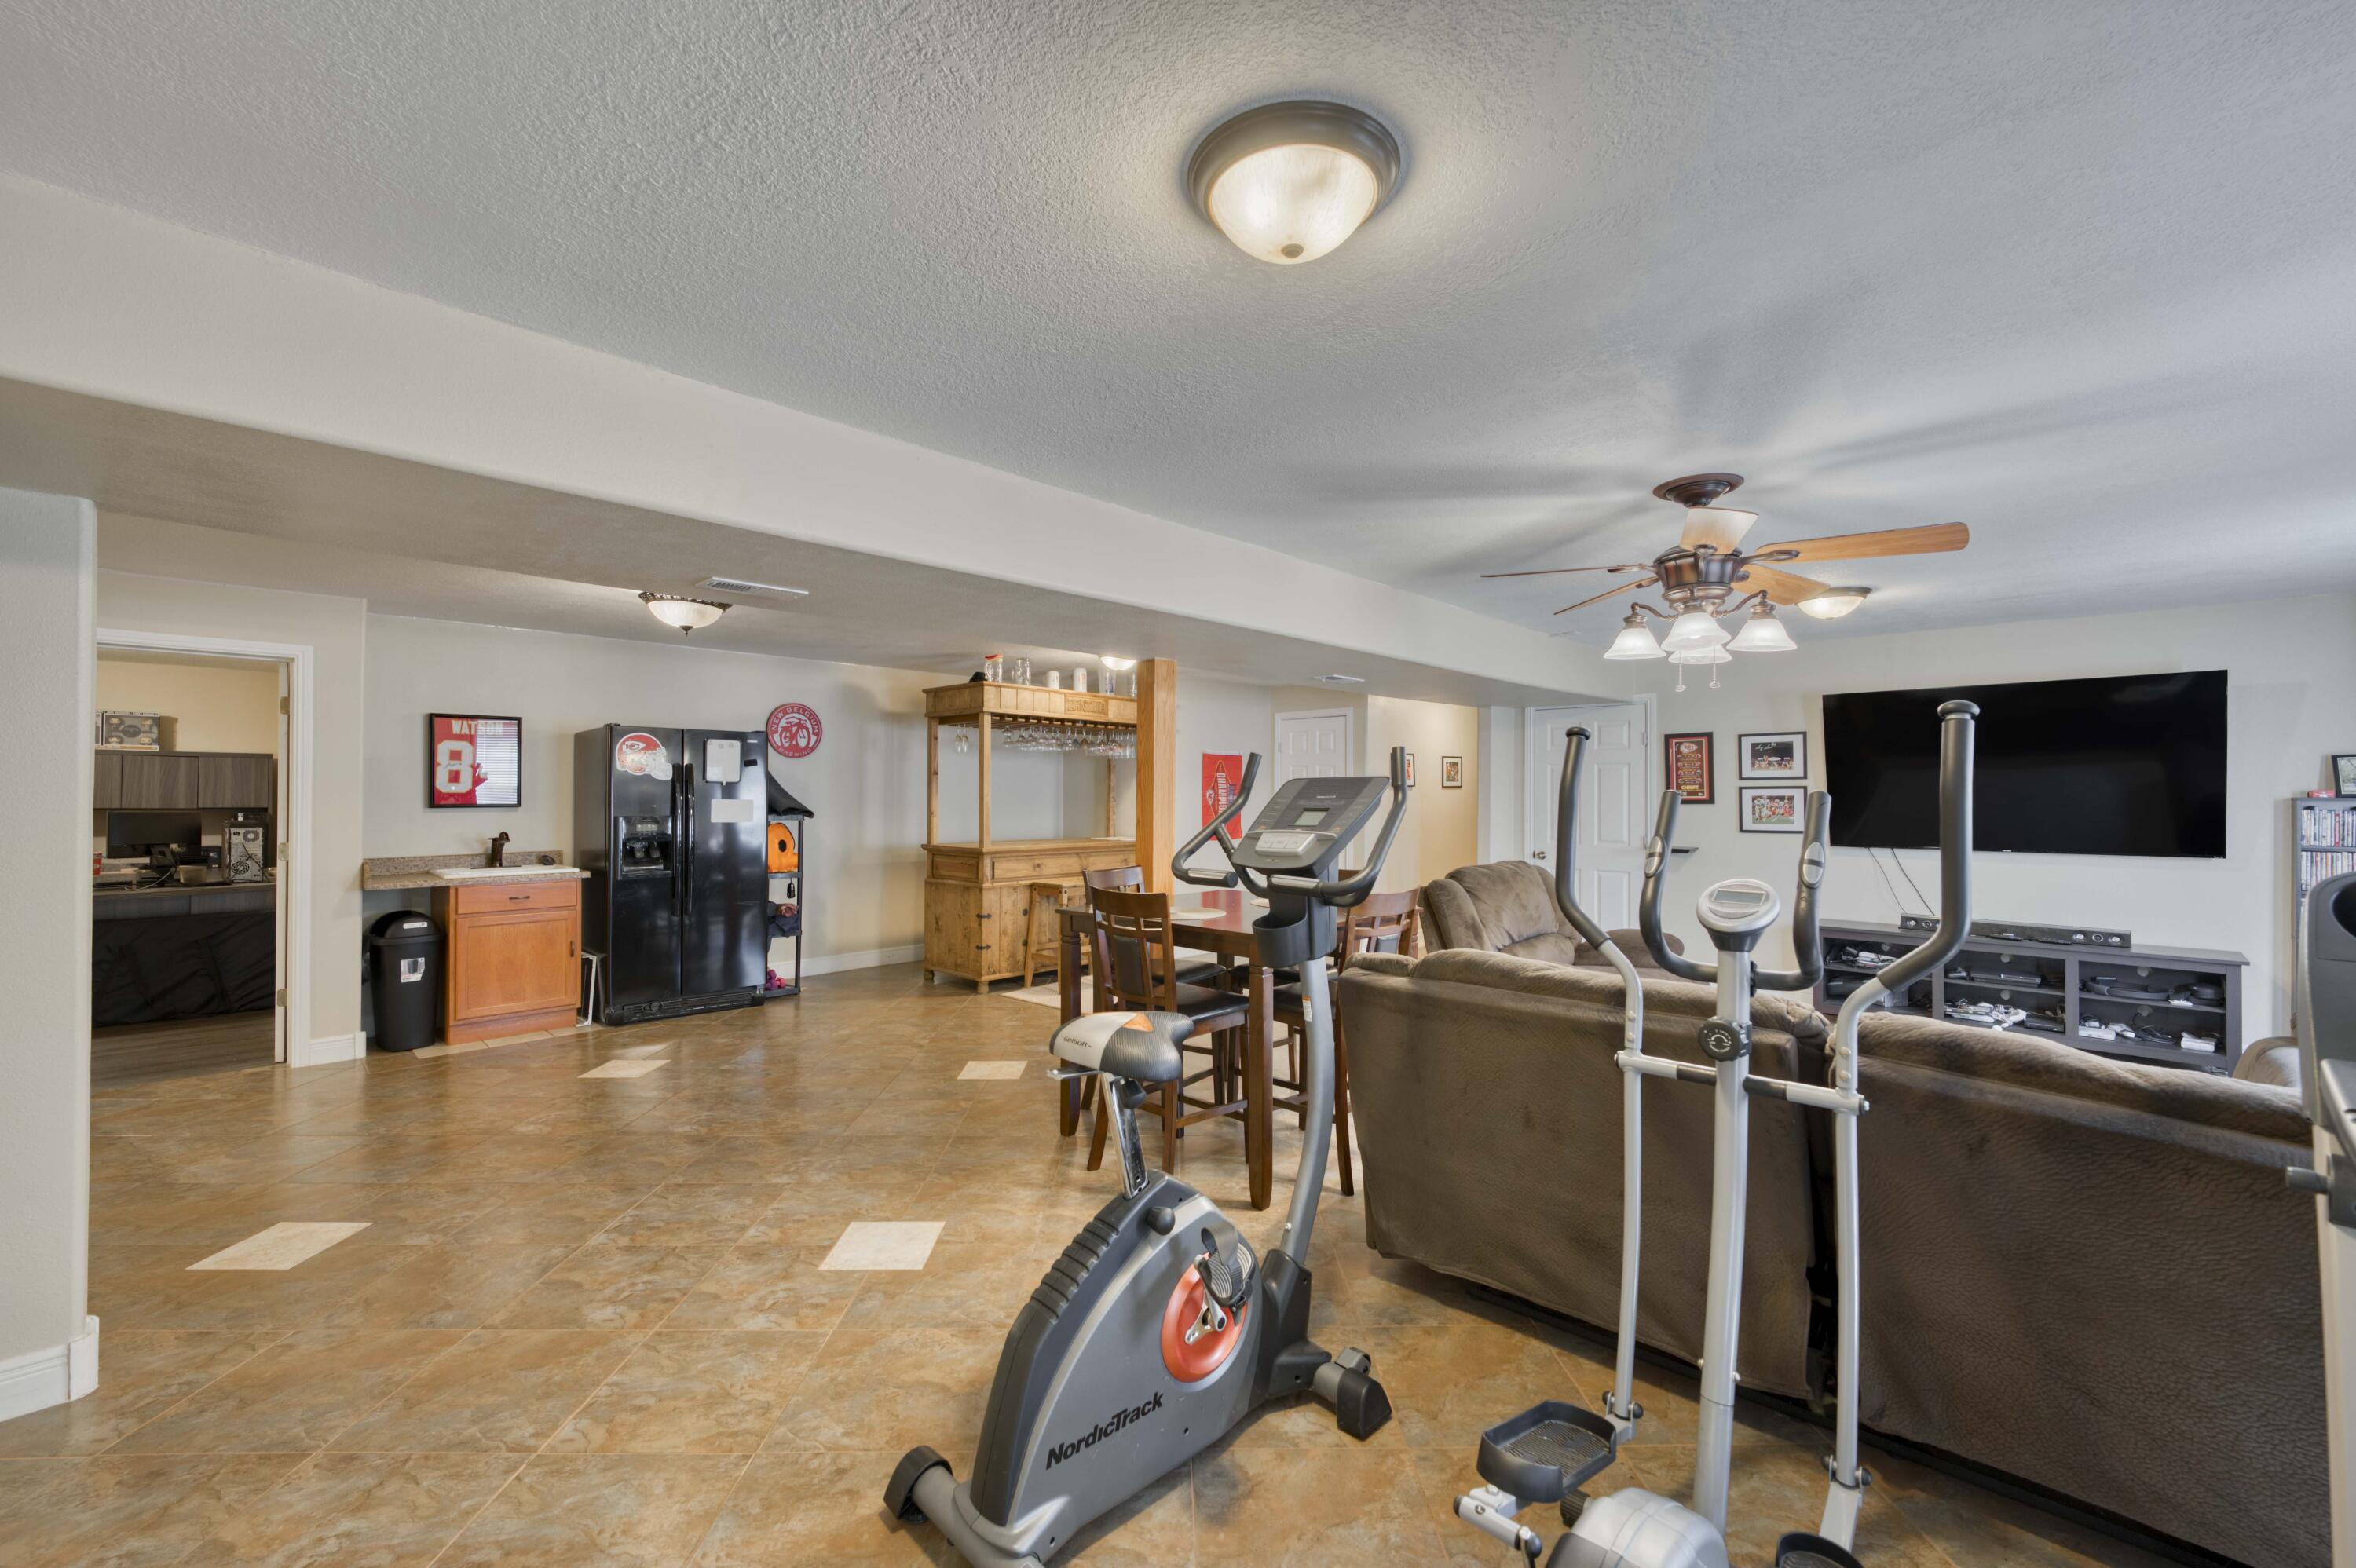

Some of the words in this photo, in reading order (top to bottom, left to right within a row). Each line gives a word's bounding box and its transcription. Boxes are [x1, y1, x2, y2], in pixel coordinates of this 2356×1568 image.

[452, 720, 503, 736] WATSON
[772, 711, 784, 730] NEW
[786, 707, 818, 733] BELGIUM
[779, 747, 812, 757] BREWING
[436, 740, 474, 793] 8
[1045, 1391, 1164, 1470] NordicTrack
